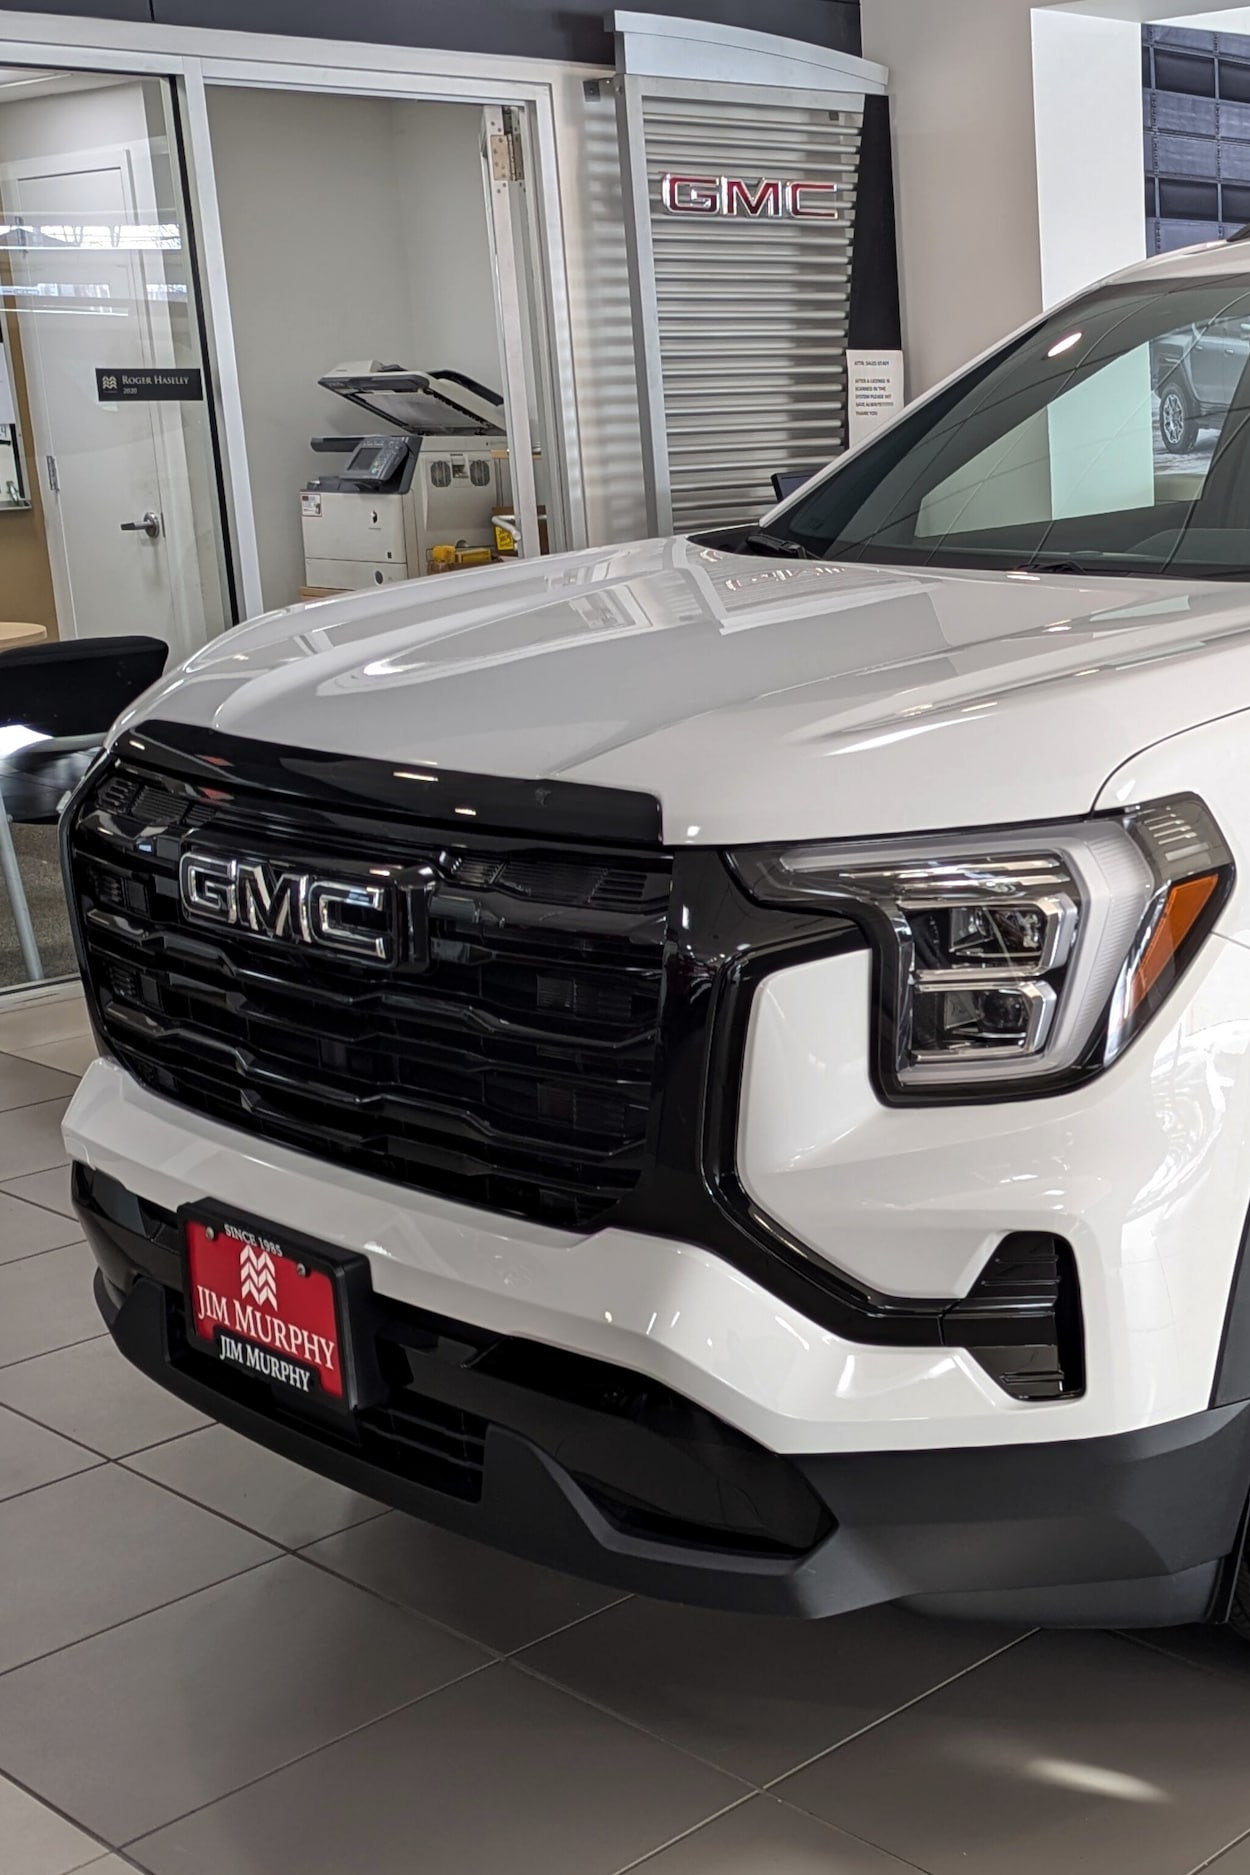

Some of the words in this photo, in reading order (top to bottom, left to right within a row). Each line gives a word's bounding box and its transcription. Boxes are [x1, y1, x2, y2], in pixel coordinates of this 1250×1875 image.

[662, 174, 838, 219] GMC
[179, 852, 387, 960] GMC
[224, 1223, 257, 1248] SINCE
[258, 1236, 283, 1257] 1985
[197, 1285, 231, 1326] JIM
[233, 1299, 335, 1370] MURPHY
[220, 1335, 244, 1364] JIM
[245, 1344, 310, 1392] MURPHY
